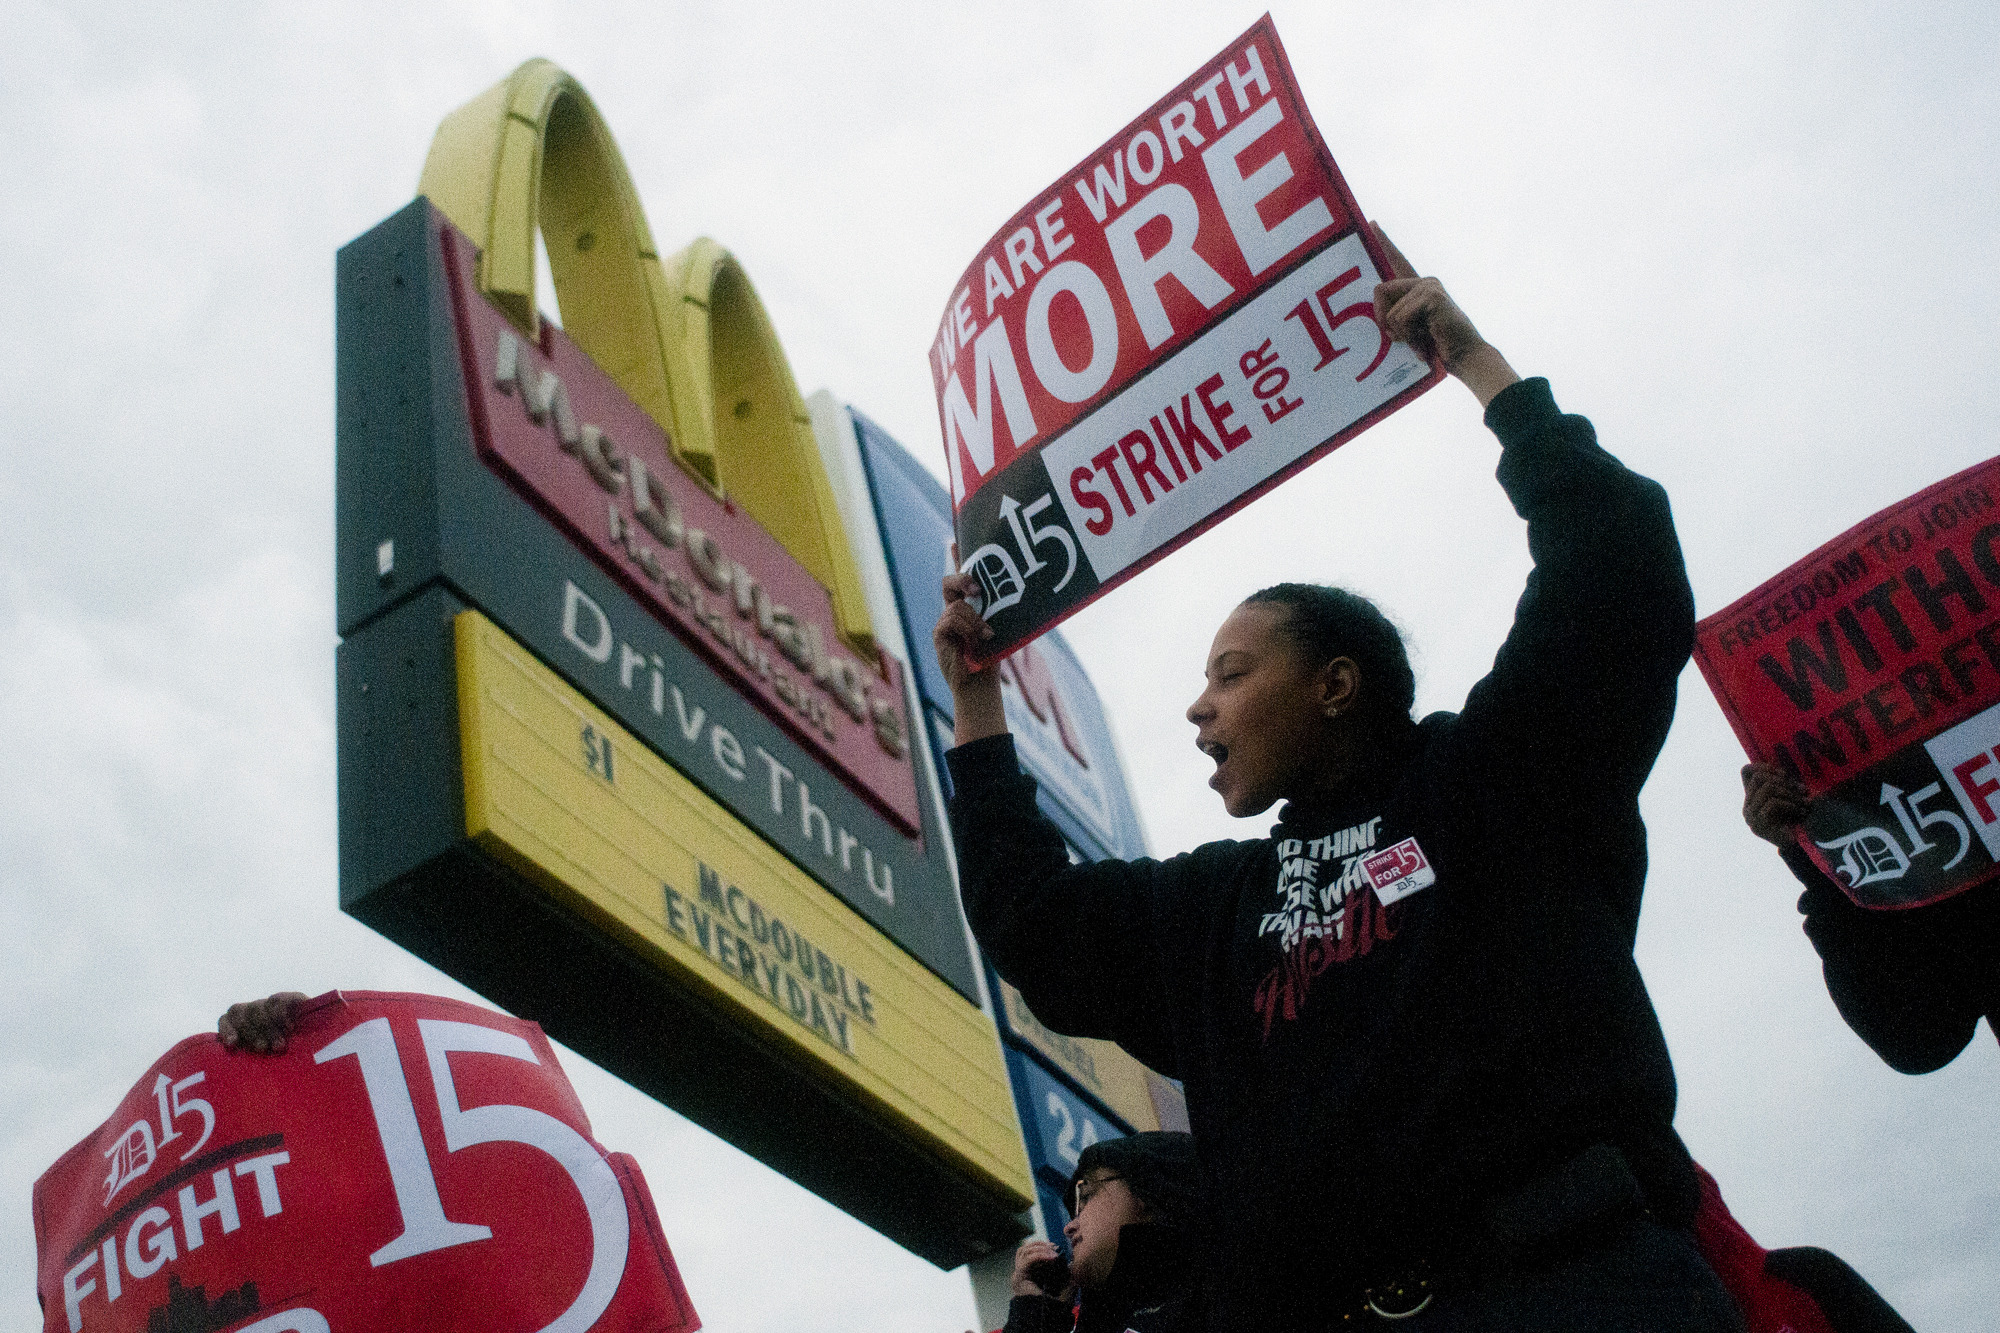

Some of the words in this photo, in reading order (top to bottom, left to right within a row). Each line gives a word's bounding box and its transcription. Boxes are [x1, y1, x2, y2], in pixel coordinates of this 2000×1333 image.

[938, 286, 978, 382] WE
[985, 198, 1075, 317] ARE
[1076, 45, 1272, 224] WORTH
[943, 97, 1334, 507] MORE
[1070, 373, 1252, 537] STRIKE
[1239, 337, 1304, 425] FOR
[1284, 266, 1392, 382] 15
[1720, 548, 1869, 656] FREEDOM
[1867, 526, 1912, 563] TO
[1918, 482, 1995, 541] JOIN
[581, 724, 614, 784] $1
[1952, 742, 2000, 826] F
[1367, 853, 1393, 869] STRIKE
[1375, 866, 1402, 884] FOR
[1392, 842, 1420, 872] 15
[662, 880, 850, 1052] EVERYDAY
[64, 1151, 290, 1333] FIGHT
[313, 1016, 629, 1333] 15
